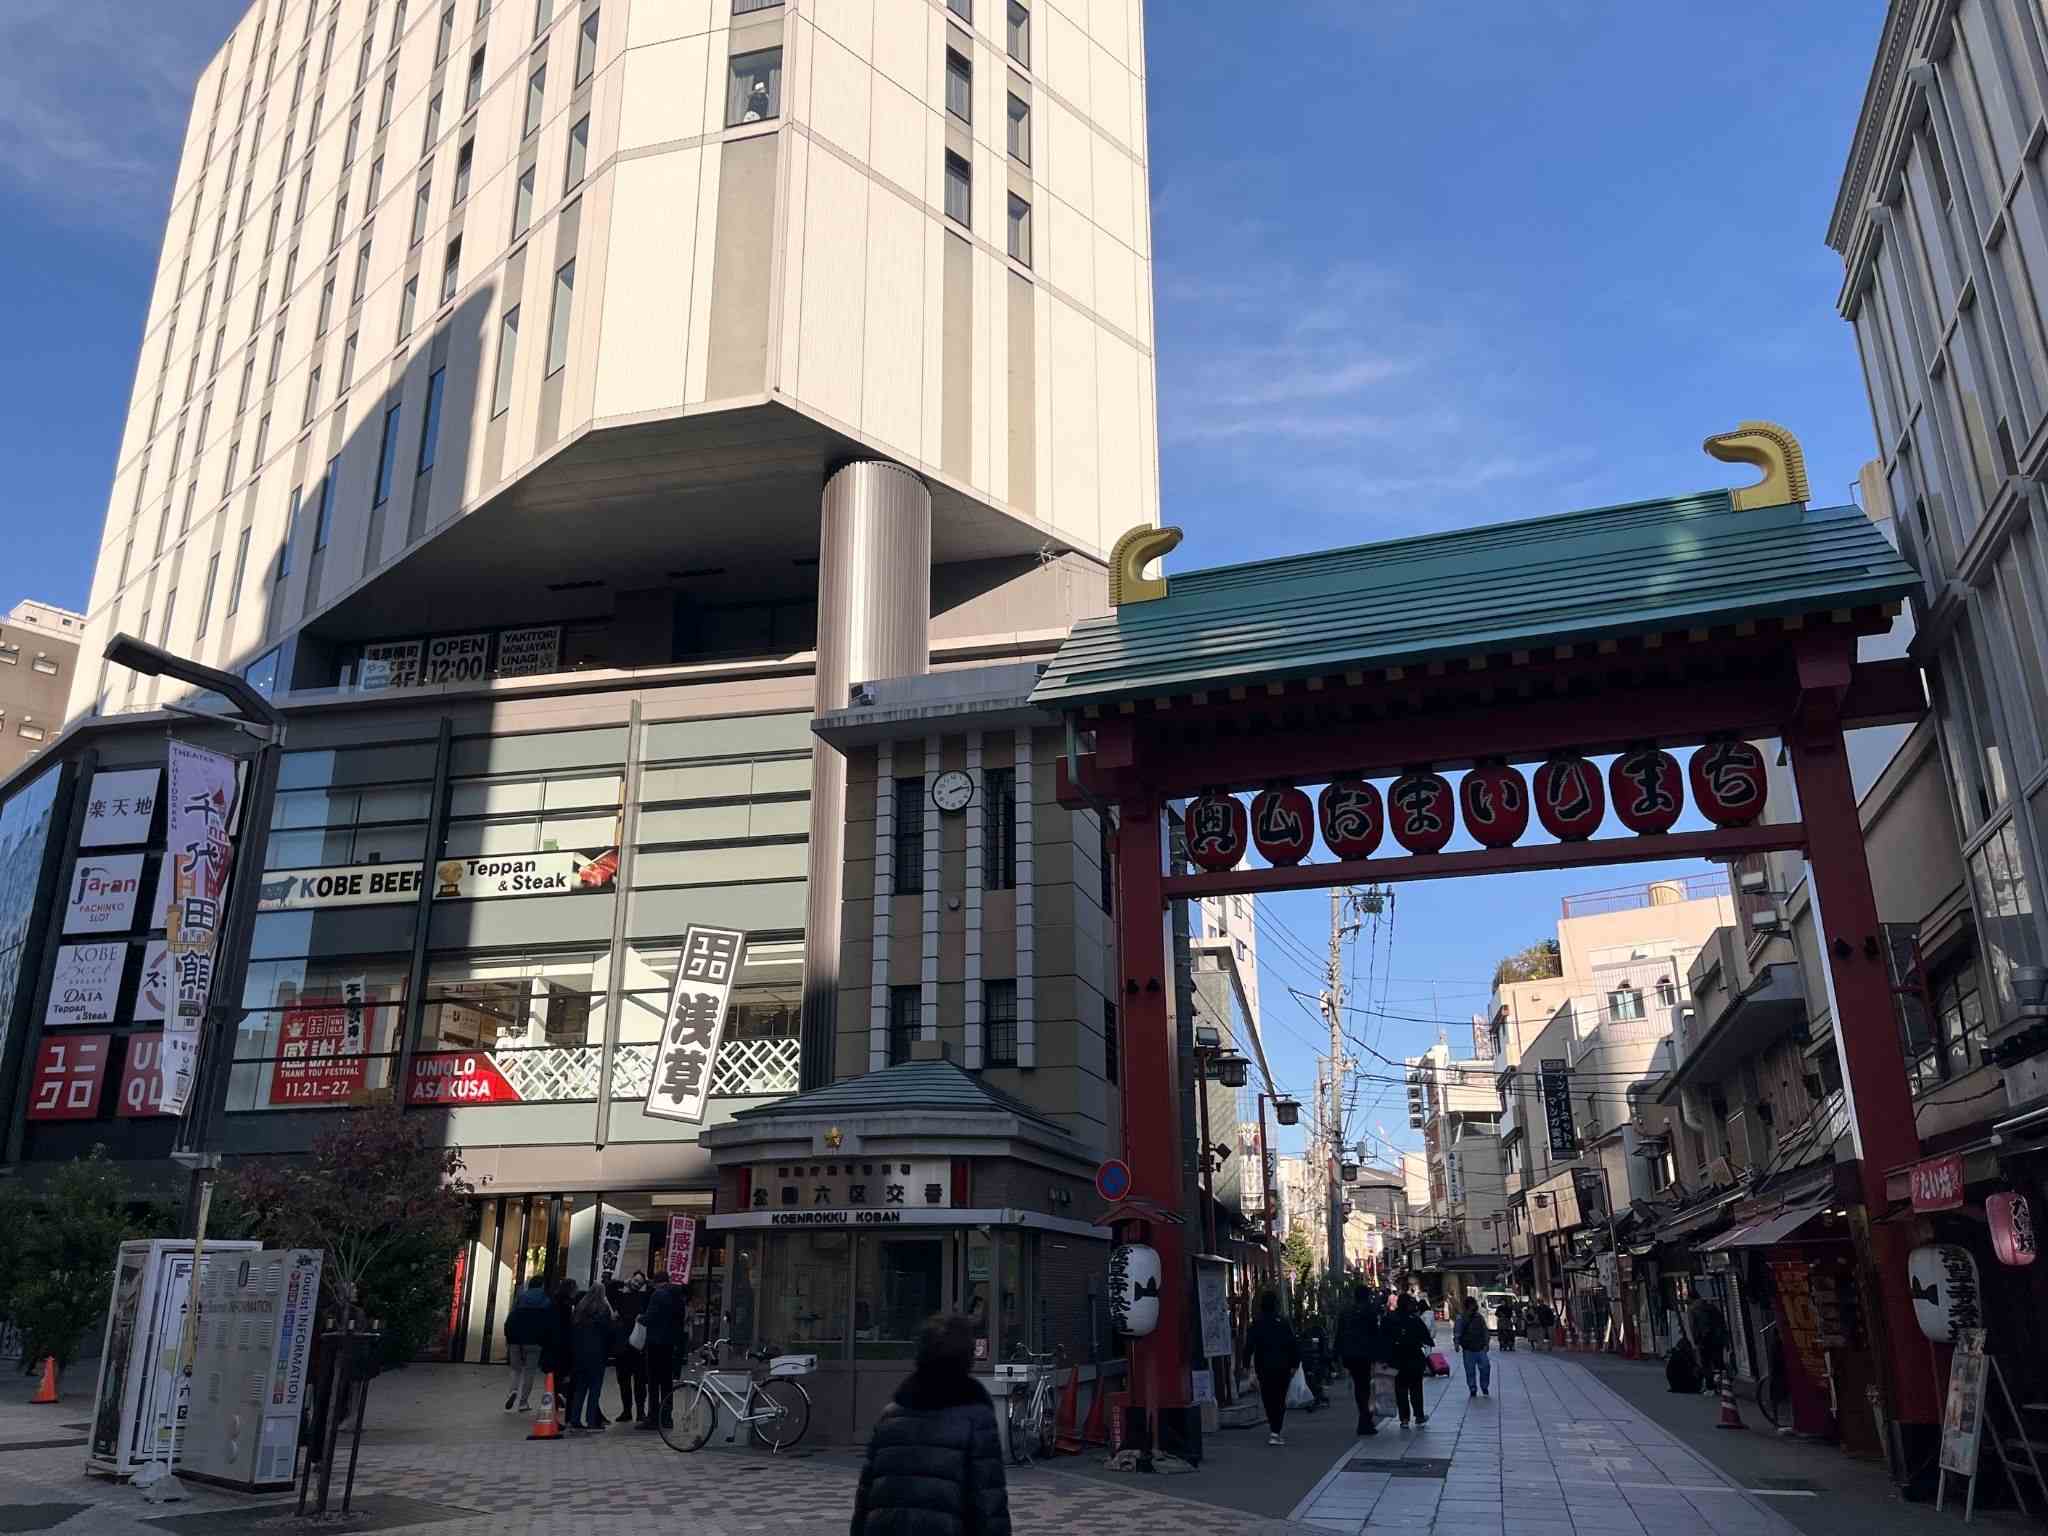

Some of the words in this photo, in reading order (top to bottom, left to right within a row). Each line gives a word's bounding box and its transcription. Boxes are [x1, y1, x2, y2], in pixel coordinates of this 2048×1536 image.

[432, 637, 486, 657] OPEN
[431, 656, 482, 683] 12:00
[88, 796, 152, 818] 楽天地
[467, 860, 536, 877] Teppan
[181, 791, 219, 990] 千代田館
[299, 874, 362, 898] KOBE
[498, 879, 508, 890] &
[512, 873, 567, 890] Steak
[89, 914, 111, 922] SLOT
[72, 946, 119, 962] KOBE
[53, 1004, 86, 1014] Teppan
[657, 992, 720, 1104] 浅草
[281, 1070, 305, 1078] THANK
[325, 1067, 359, 1076] FESTIVAL
[416, 1058, 476, 1077] UNIQLO
[413, 1079, 491, 1098] ASAKUSA
[772, 1211, 848, 1224] KOENROKKU
[856, 1211, 901, 1222] KOBAN
[287, 1314, 309, 1404] INFORMATION
